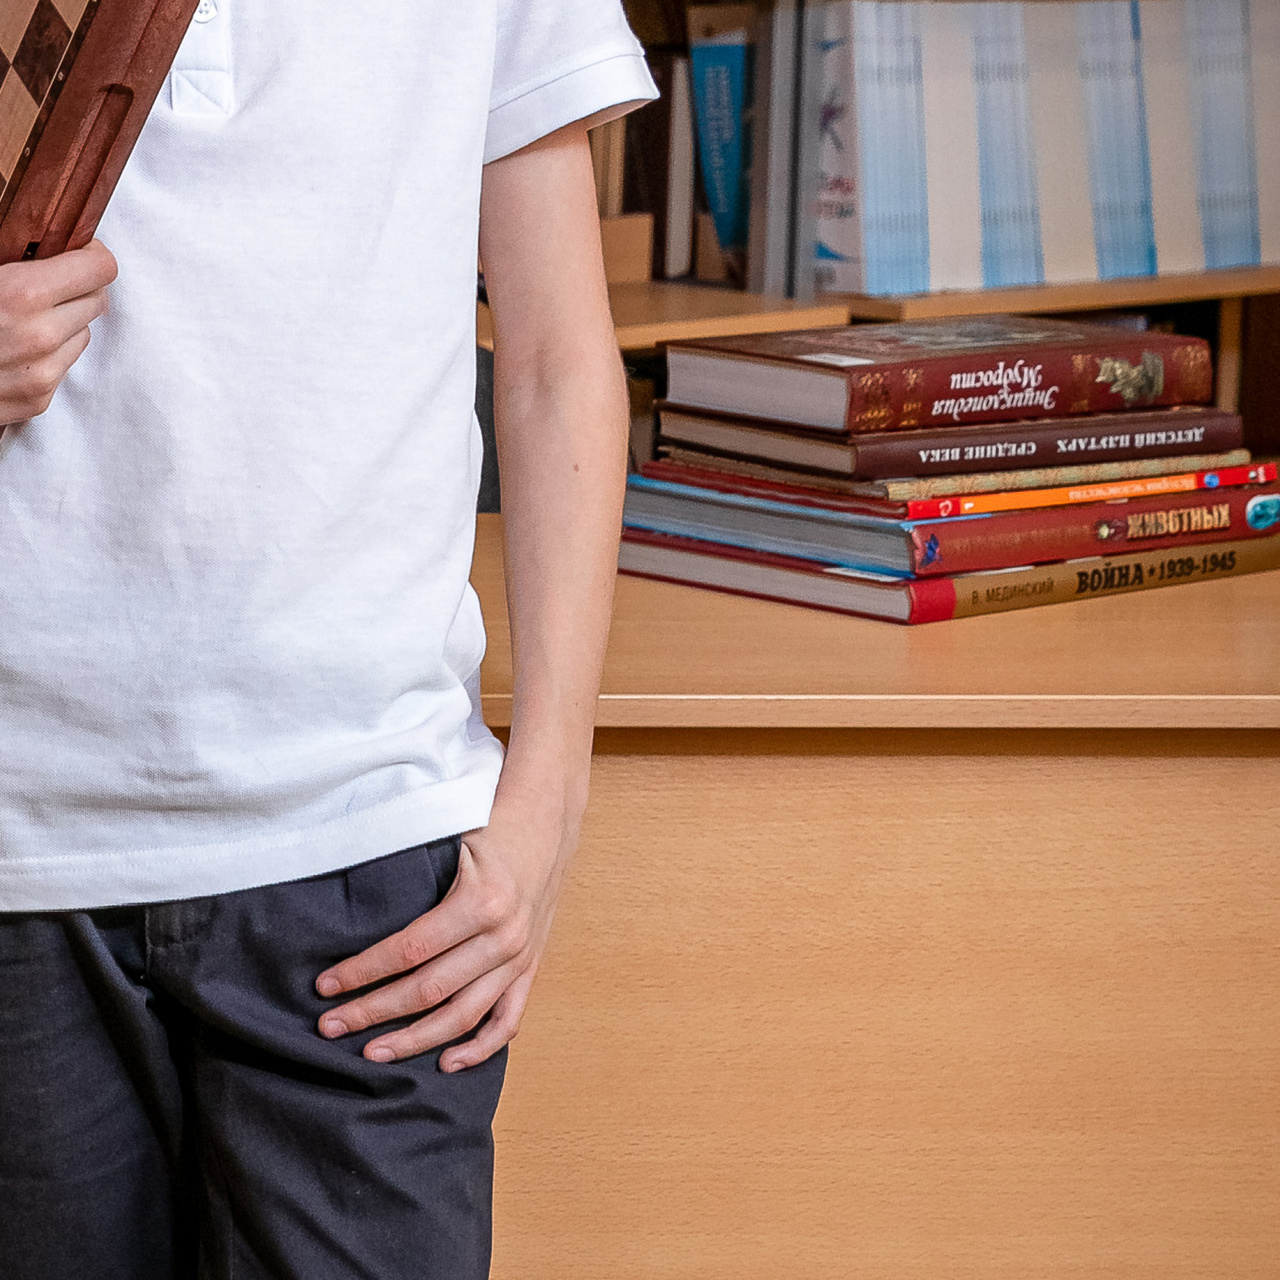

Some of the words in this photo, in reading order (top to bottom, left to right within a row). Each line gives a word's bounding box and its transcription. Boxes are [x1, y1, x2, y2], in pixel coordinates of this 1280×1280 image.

[951, 359, 1043, 391] Мудрости
[931, 385, 1059, 418] Энциклопедия
[964, 440, 1037, 460] СРЕДНИЕ
[1057, 432, 1131, 453] ПЛУТАРХ
[1134, 425, 1206, 449] ДЕТСКИЙ
[919, 445, 960, 463] ВЕКА
[1127, 503, 1231, 538] ЖИВОТНЫХ
[986, 578, 1057, 604] МЕДИНСКИЙ
[1075, 562, 1145, 594] ВОЙНА
[1158, 550, 1237, 582] 1939-1945
